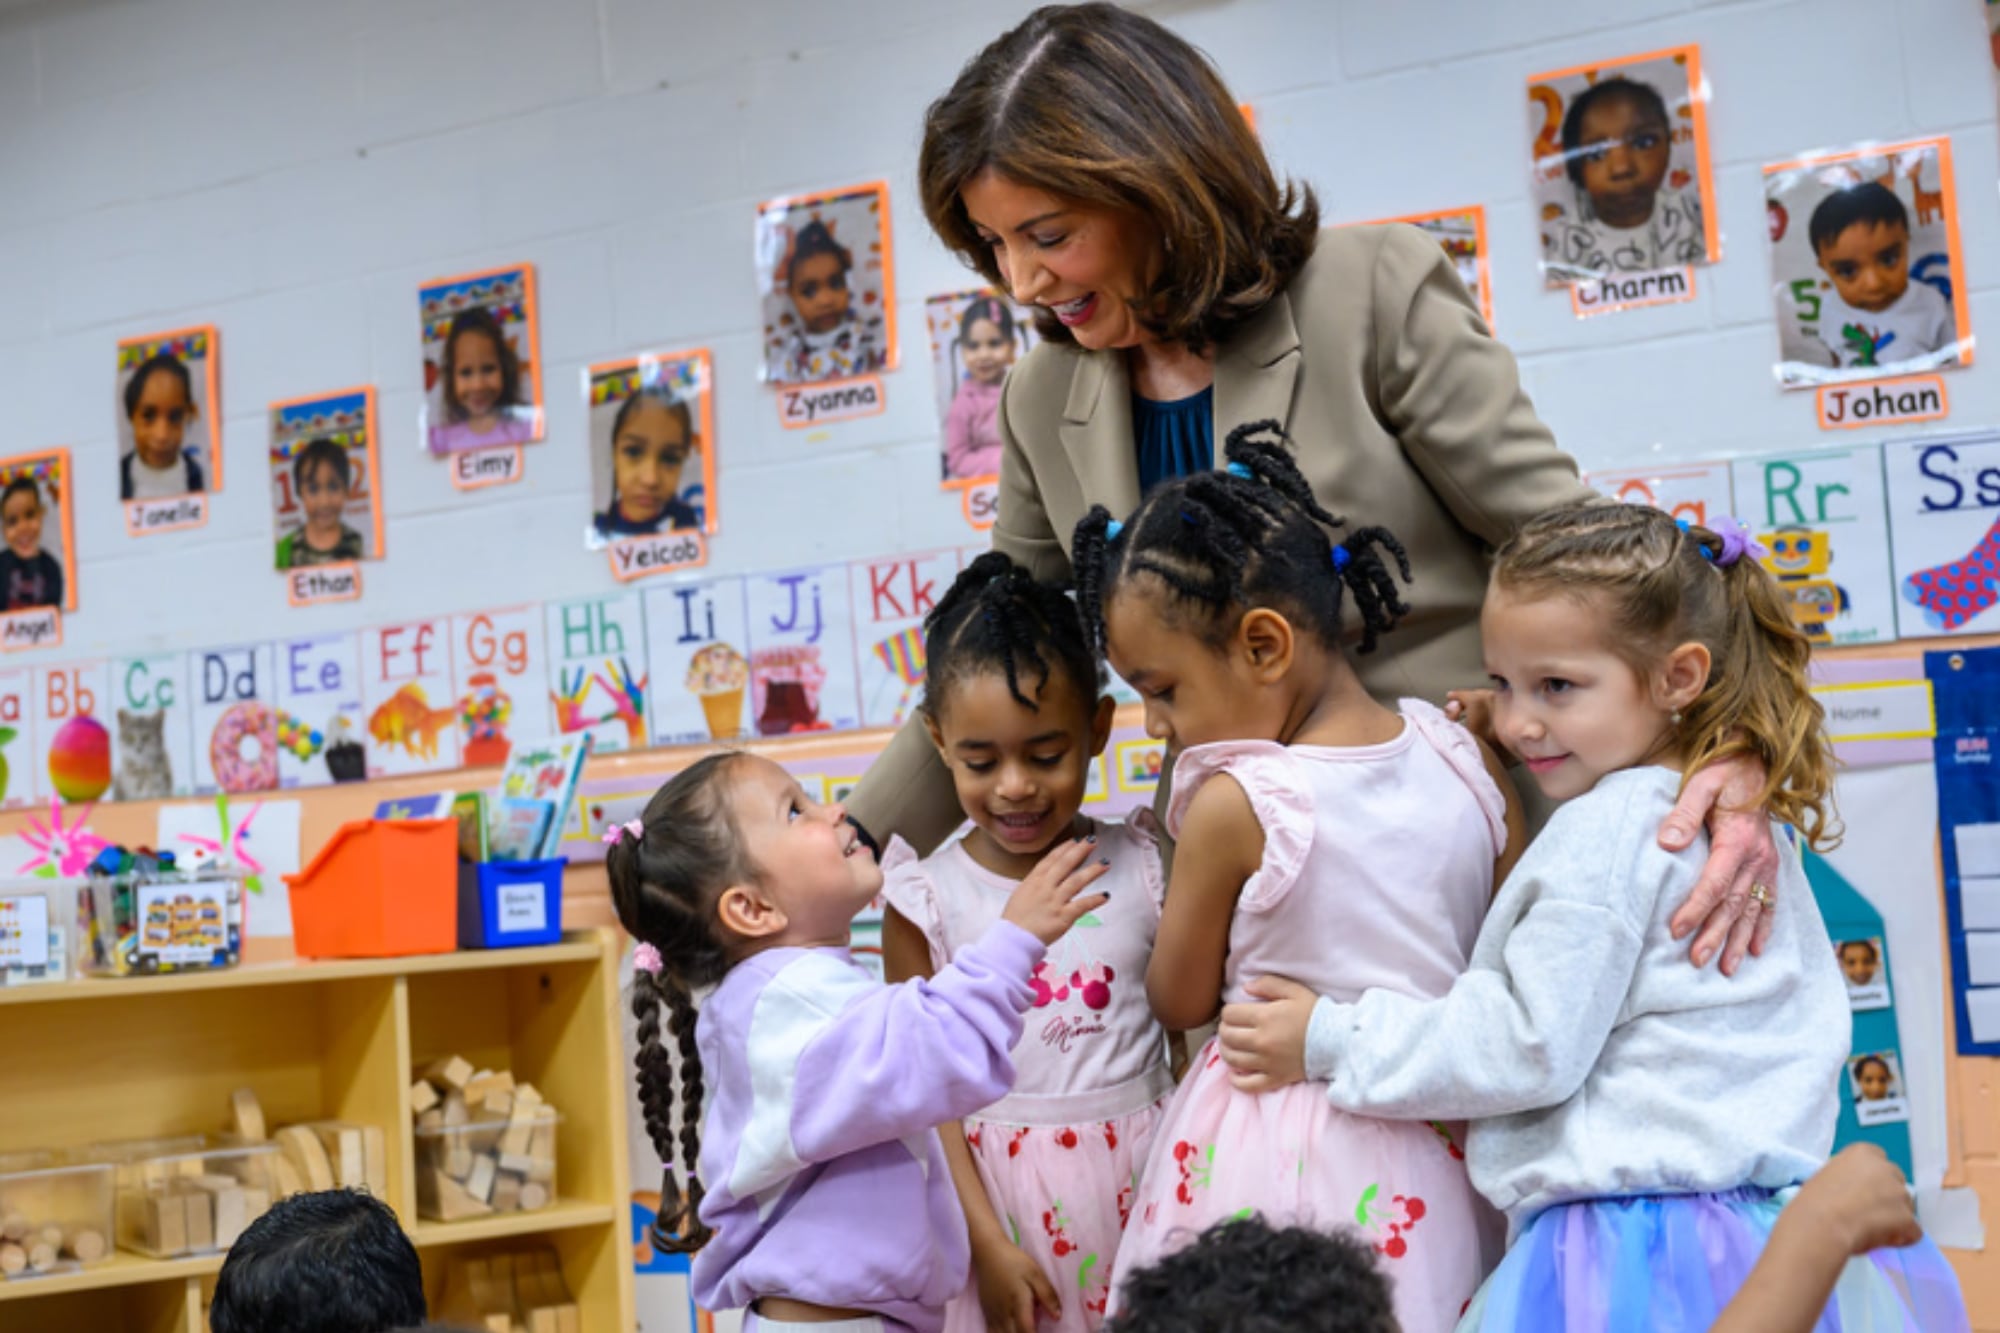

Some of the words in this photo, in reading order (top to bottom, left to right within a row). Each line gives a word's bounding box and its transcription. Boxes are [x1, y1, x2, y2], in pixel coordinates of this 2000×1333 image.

[1790, 278, 1822, 321] 5
[784, 385, 877, 420] Zyanna
[1826, 387, 1941, 423] Johan
[456, 452, 515, 479] Eimy
[131, 504, 202, 528] Janelle
[1762, 460, 1850, 526] Rr
[615, 538, 699, 570] Yeicob
[293, 571, 356, 599] Ethan
[771, 575, 822, 643] Jj
[869, 560, 938, 621] Kk
[3, 615, 56, 643] Angel
[562, 602, 625, 659] Hh
[674, 587, 716, 643] Ii
[379, 622, 434, 681] Ff
[466, 614, 527, 675] Gg
[47, 669, 95, 719] Bb
[124, 660, 175, 709] Cc
[203, 650, 257, 703] Dd
[289, 643, 342, 696] Ee
[1831, 706, 1882, 722] Home
